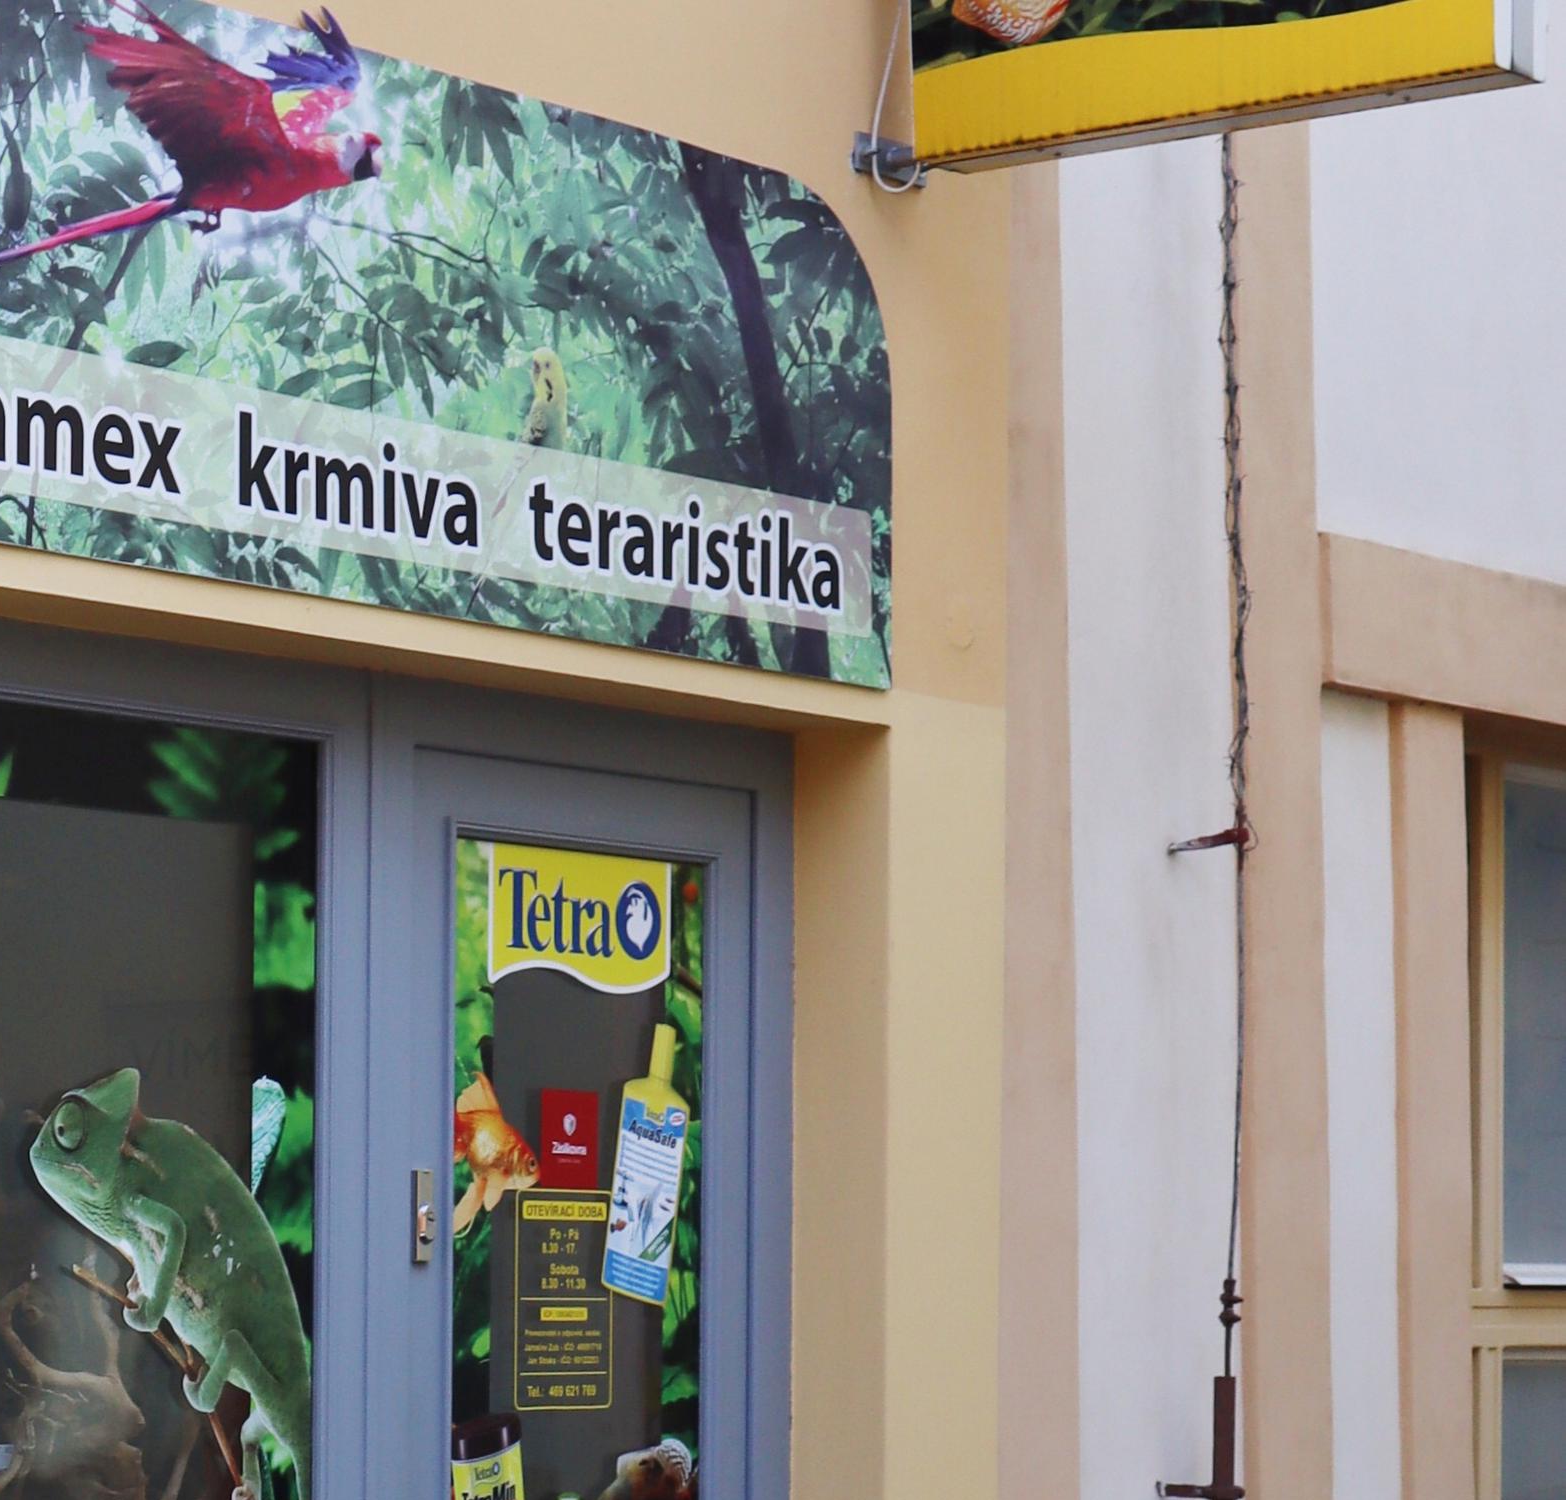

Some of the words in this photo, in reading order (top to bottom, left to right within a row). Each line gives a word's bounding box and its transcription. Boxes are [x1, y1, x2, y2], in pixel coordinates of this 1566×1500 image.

[237, 412, 480, 549] krmiva
[528, 481, 842, 611] teraristika
[498, 868, 616, 958] Tetra
[628, 1119, 678, 1150] AquaSafe
[526, 1202, 576, 1218] OTEVÍRACÍ
[578, 1205, 604, 1219] DOBA
